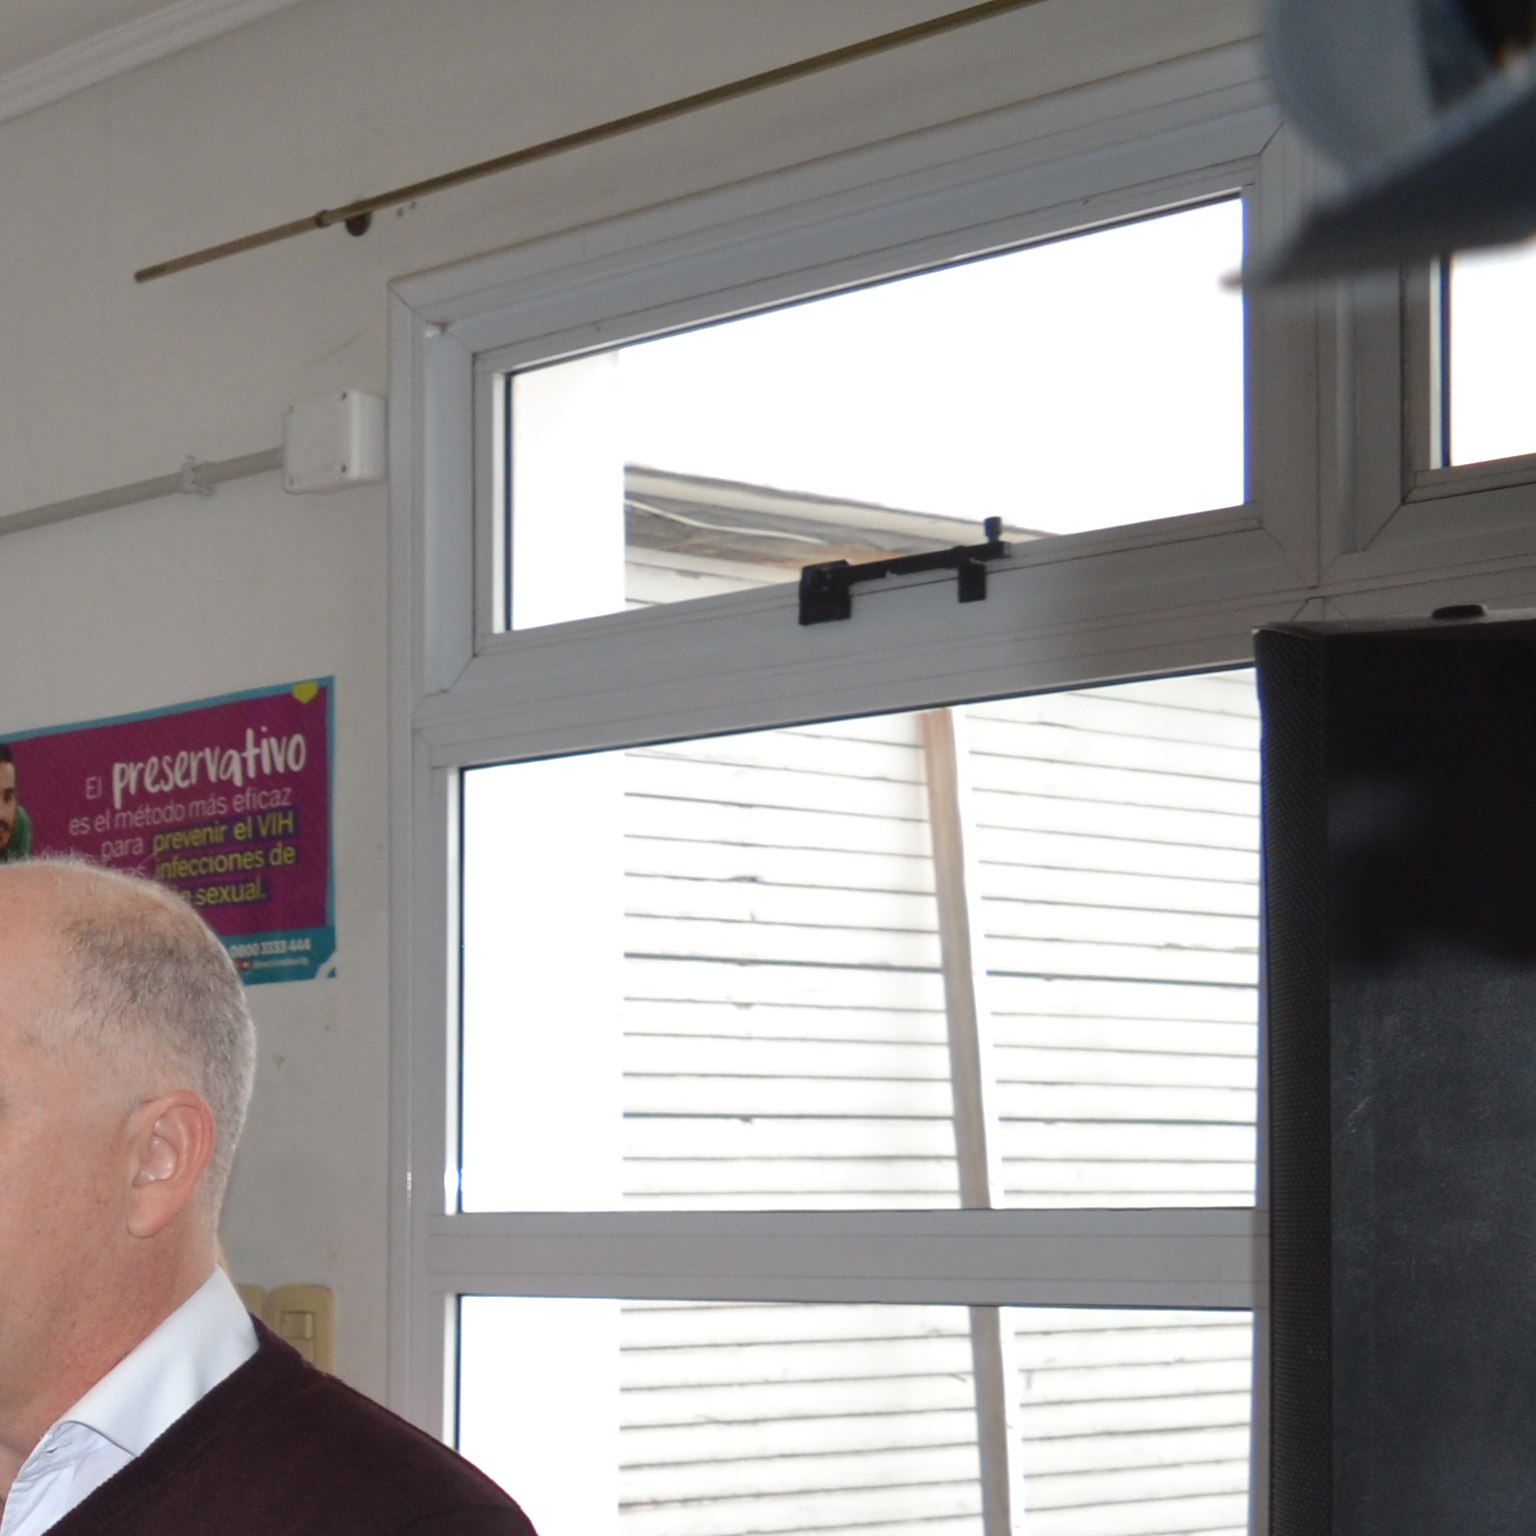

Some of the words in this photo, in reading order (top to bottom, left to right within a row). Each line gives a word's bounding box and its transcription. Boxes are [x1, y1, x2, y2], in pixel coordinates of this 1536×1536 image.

[86, 777, 102, 799] El
[113, 726, 306, 809] preservativo
[69, 817, 90, 836] es
[94, 809, 111, 832] el
[115, 801, 186, 828] método
[188, 793, 227, 817] más
[232, 787, 293, 813] eficaz
[101, 837, 144, 862] para
[153, 821, 228, 856] prevenir
[233, 815, 253, 840] el
[256, 810, 295, 837] VIH
[155, 849, 265, 882] infecciones
[269, 841, 296, 866] de
